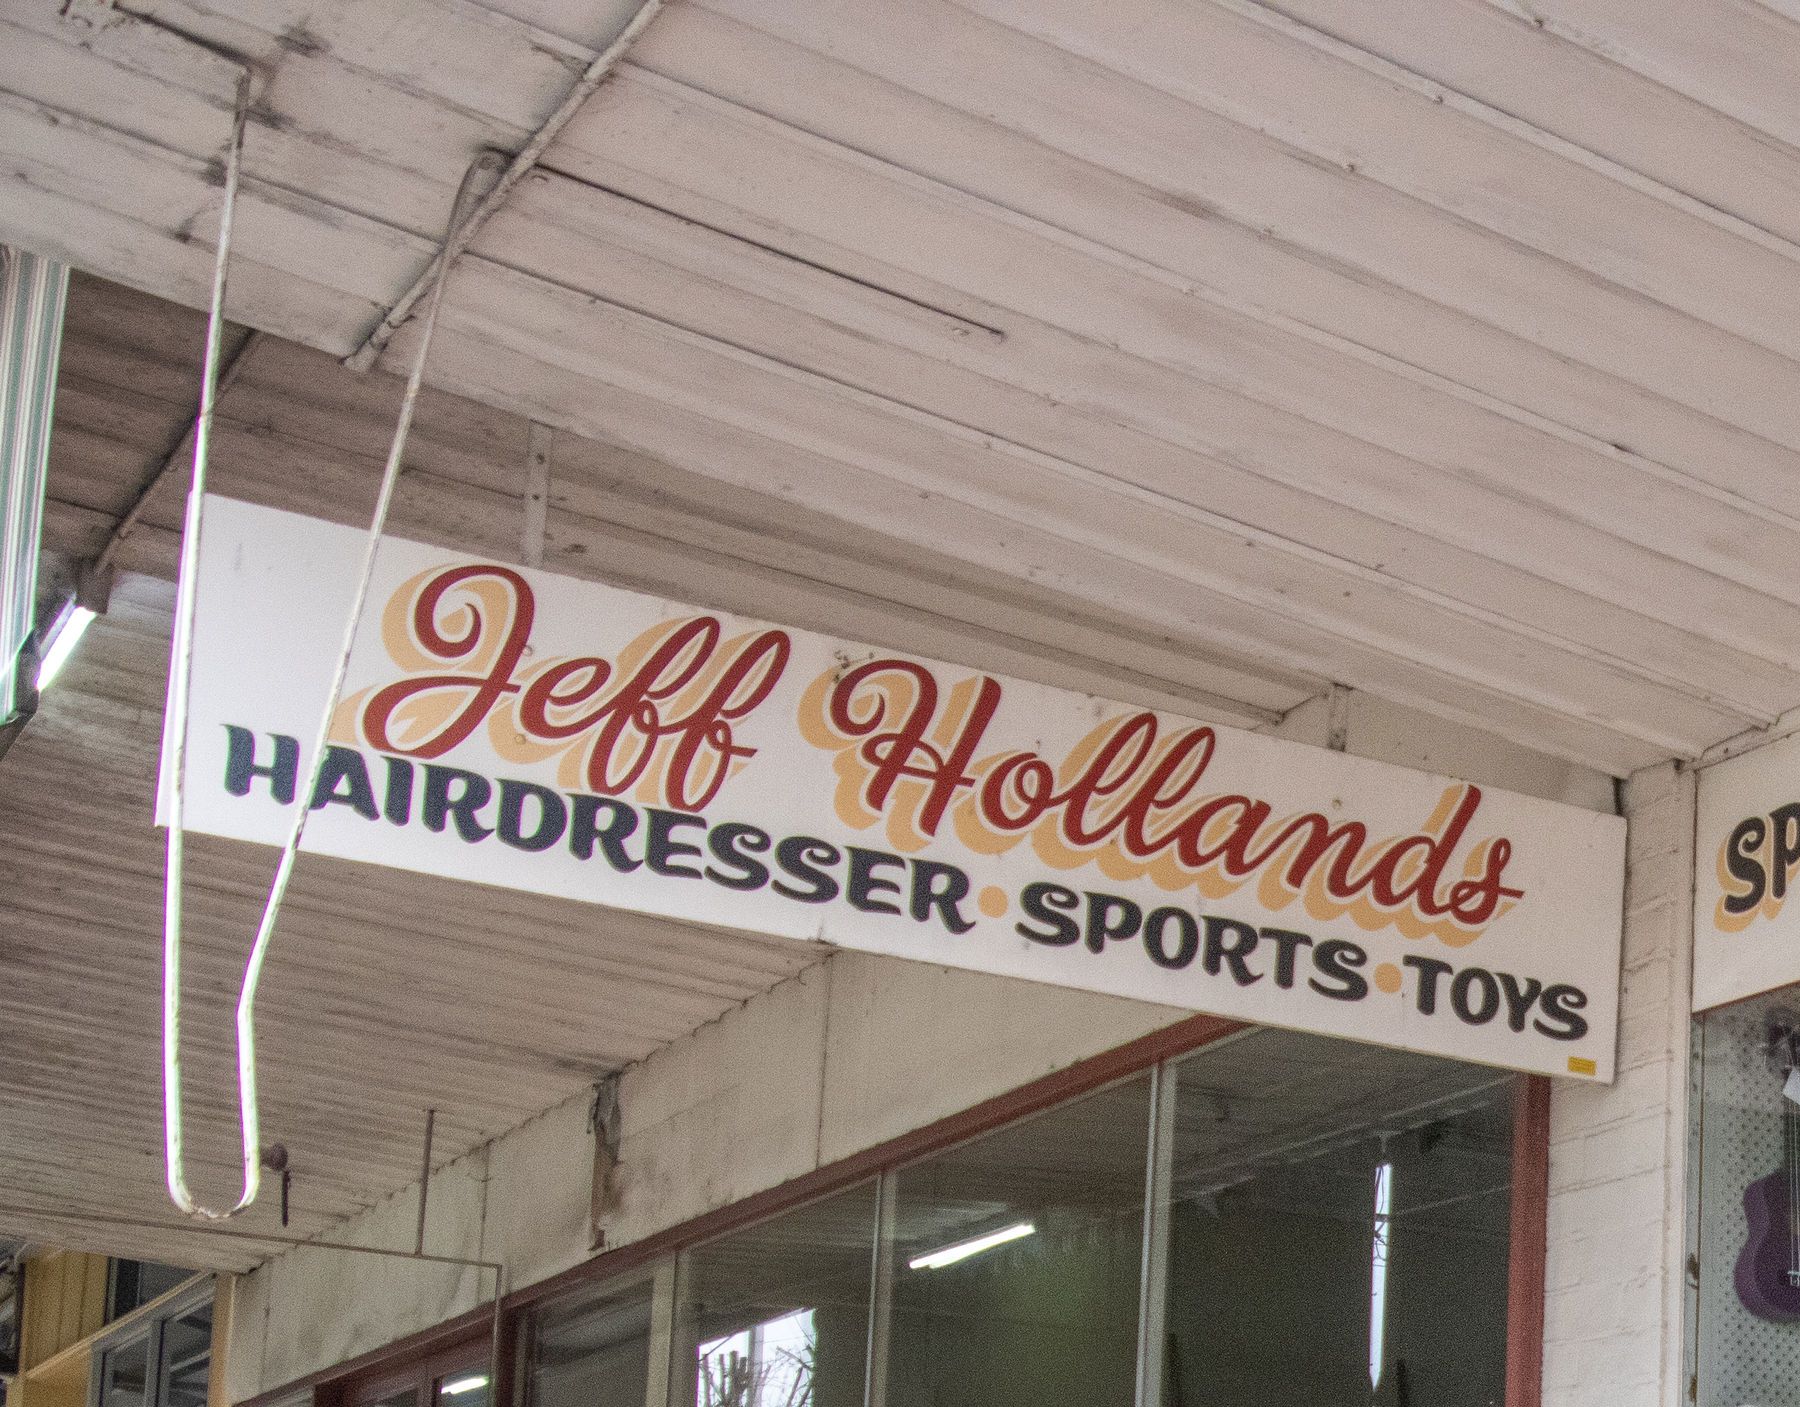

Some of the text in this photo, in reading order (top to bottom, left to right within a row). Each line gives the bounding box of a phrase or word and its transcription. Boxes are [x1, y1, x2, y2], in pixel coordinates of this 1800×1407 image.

[221, 723, 1589, 1043] HAIRDRESSER SPORTS TOYS
[362, 564, 1525, 926] Jeff Hollands
